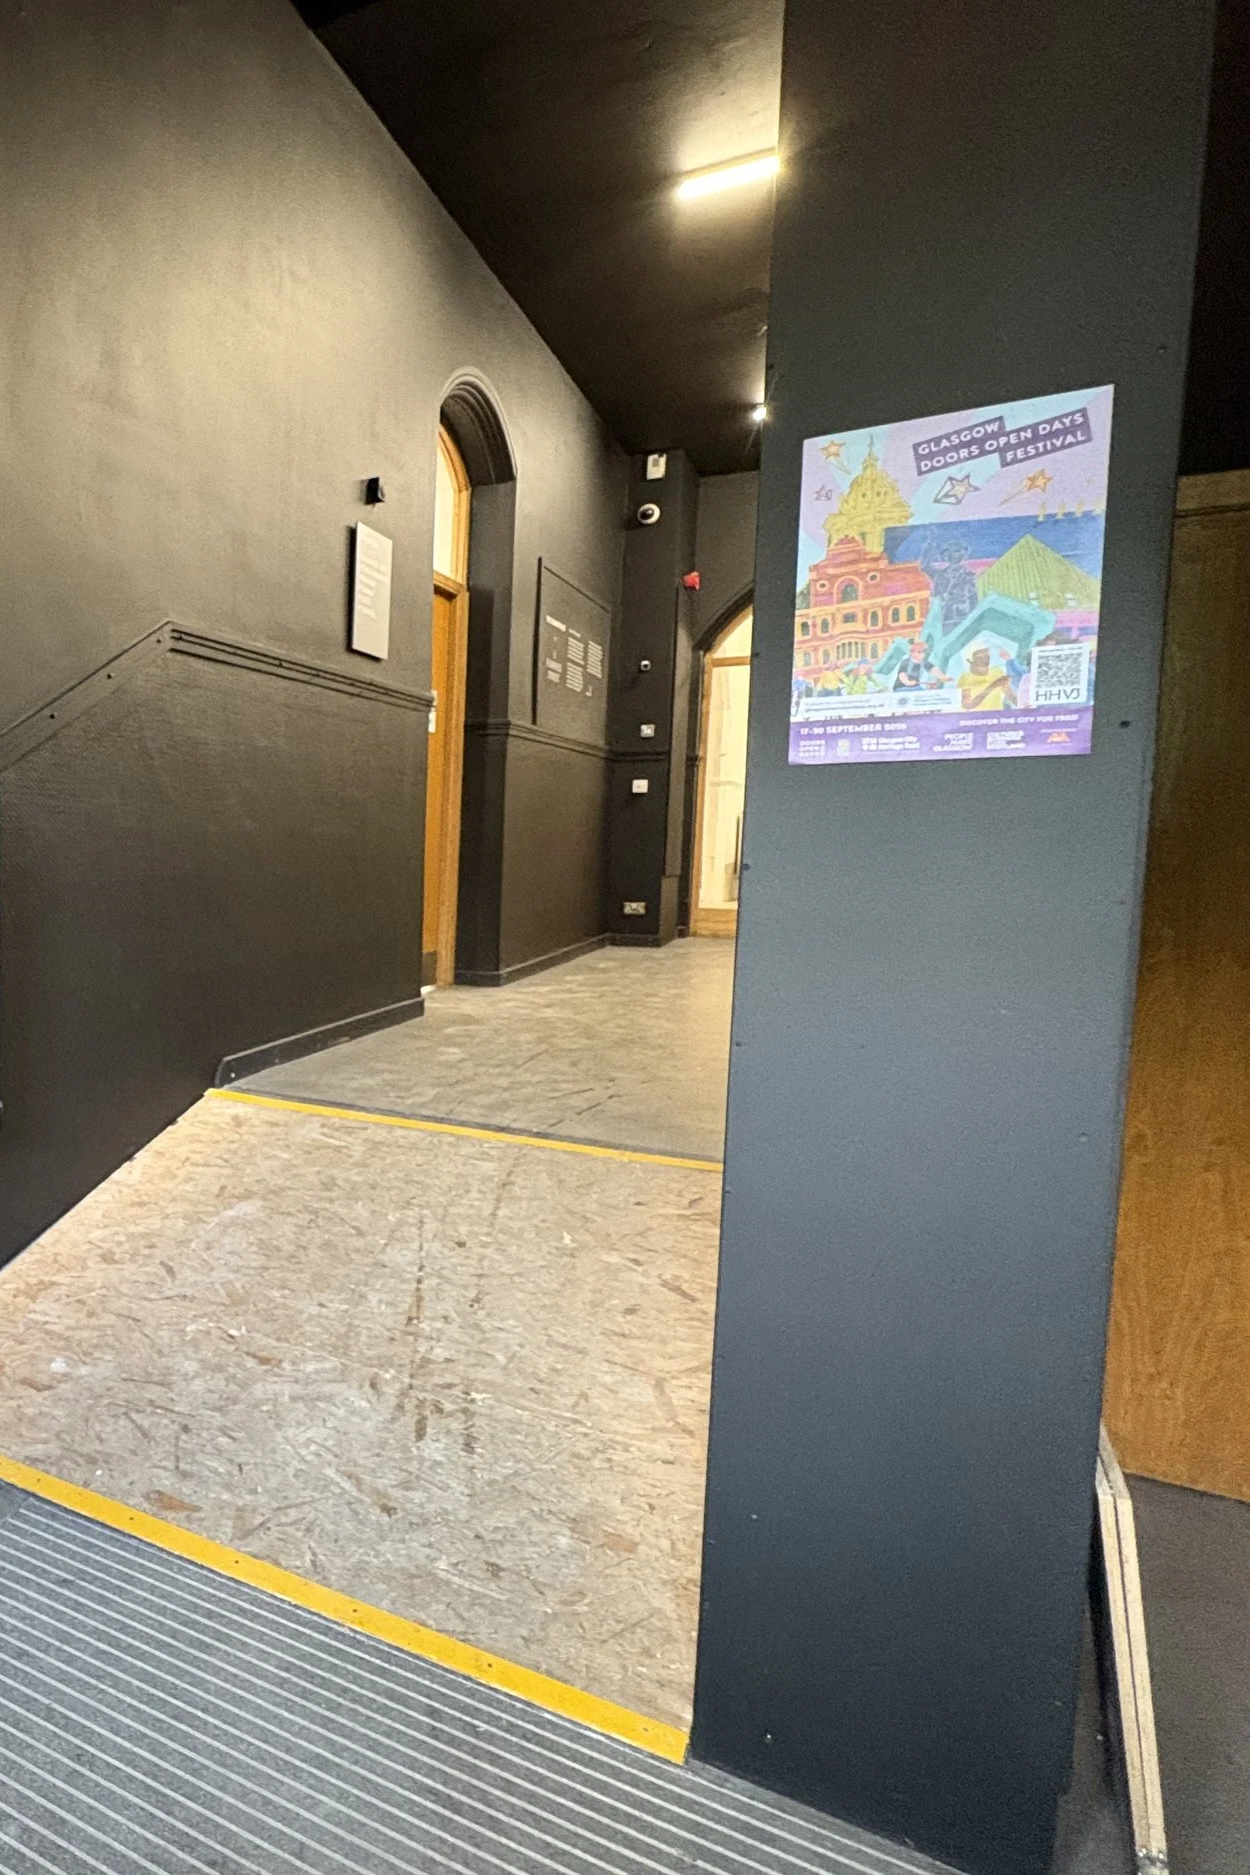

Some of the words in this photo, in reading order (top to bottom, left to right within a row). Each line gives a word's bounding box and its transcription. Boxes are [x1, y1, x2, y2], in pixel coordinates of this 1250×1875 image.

[917, 420, 1000, 455] GLASGOW
[920, 445, 980, 472] DOORS
[984, 428, 1033, 452] OPEN
[1038, 412, 1085, 435] DAYS
[1006, 430, 1088, 463] FESTIVAL
[825, 723, 882, 734] SEPTEMBER
[959, 718, 999, 727] DISCOVER
